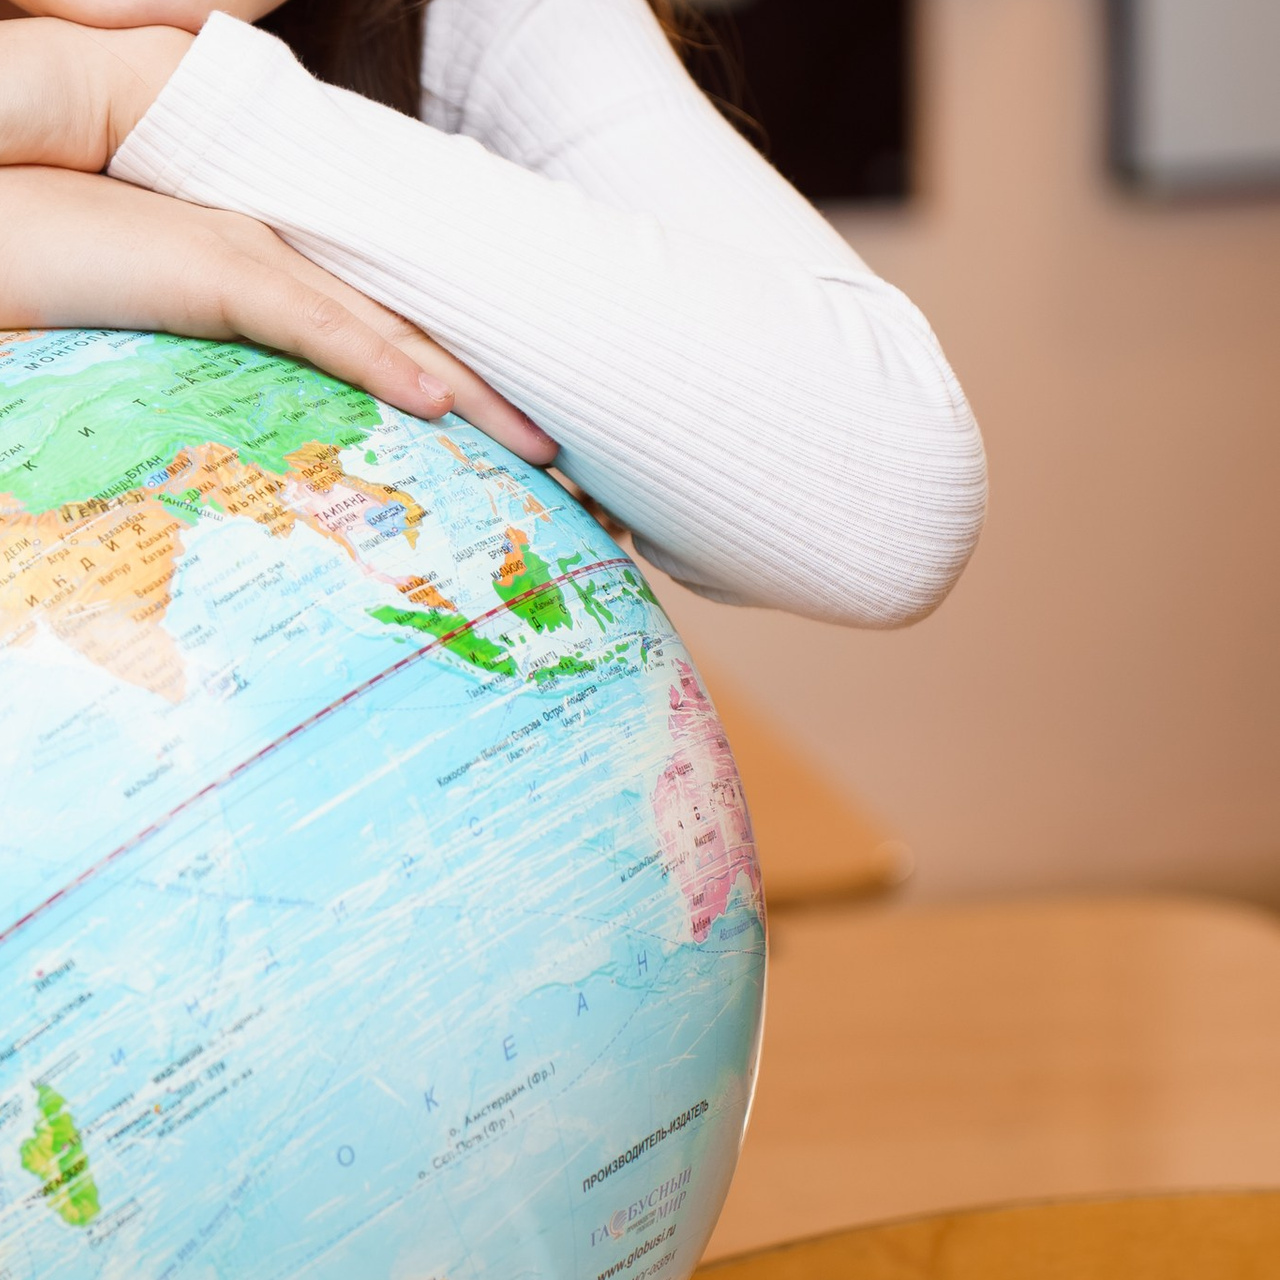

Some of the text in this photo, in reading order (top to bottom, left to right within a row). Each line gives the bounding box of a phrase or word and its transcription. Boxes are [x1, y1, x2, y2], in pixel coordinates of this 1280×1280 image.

[23, 327, 130, 373] МОНГОЛИ
[125, 452, 164, 481] БУТАН
[1, 534, 32, 563] ДЕЛИ
[579, 1097, 711, 1193] ПРОИЗВОДИТЕЛЬ-ИЗДАТЕЛЬ
